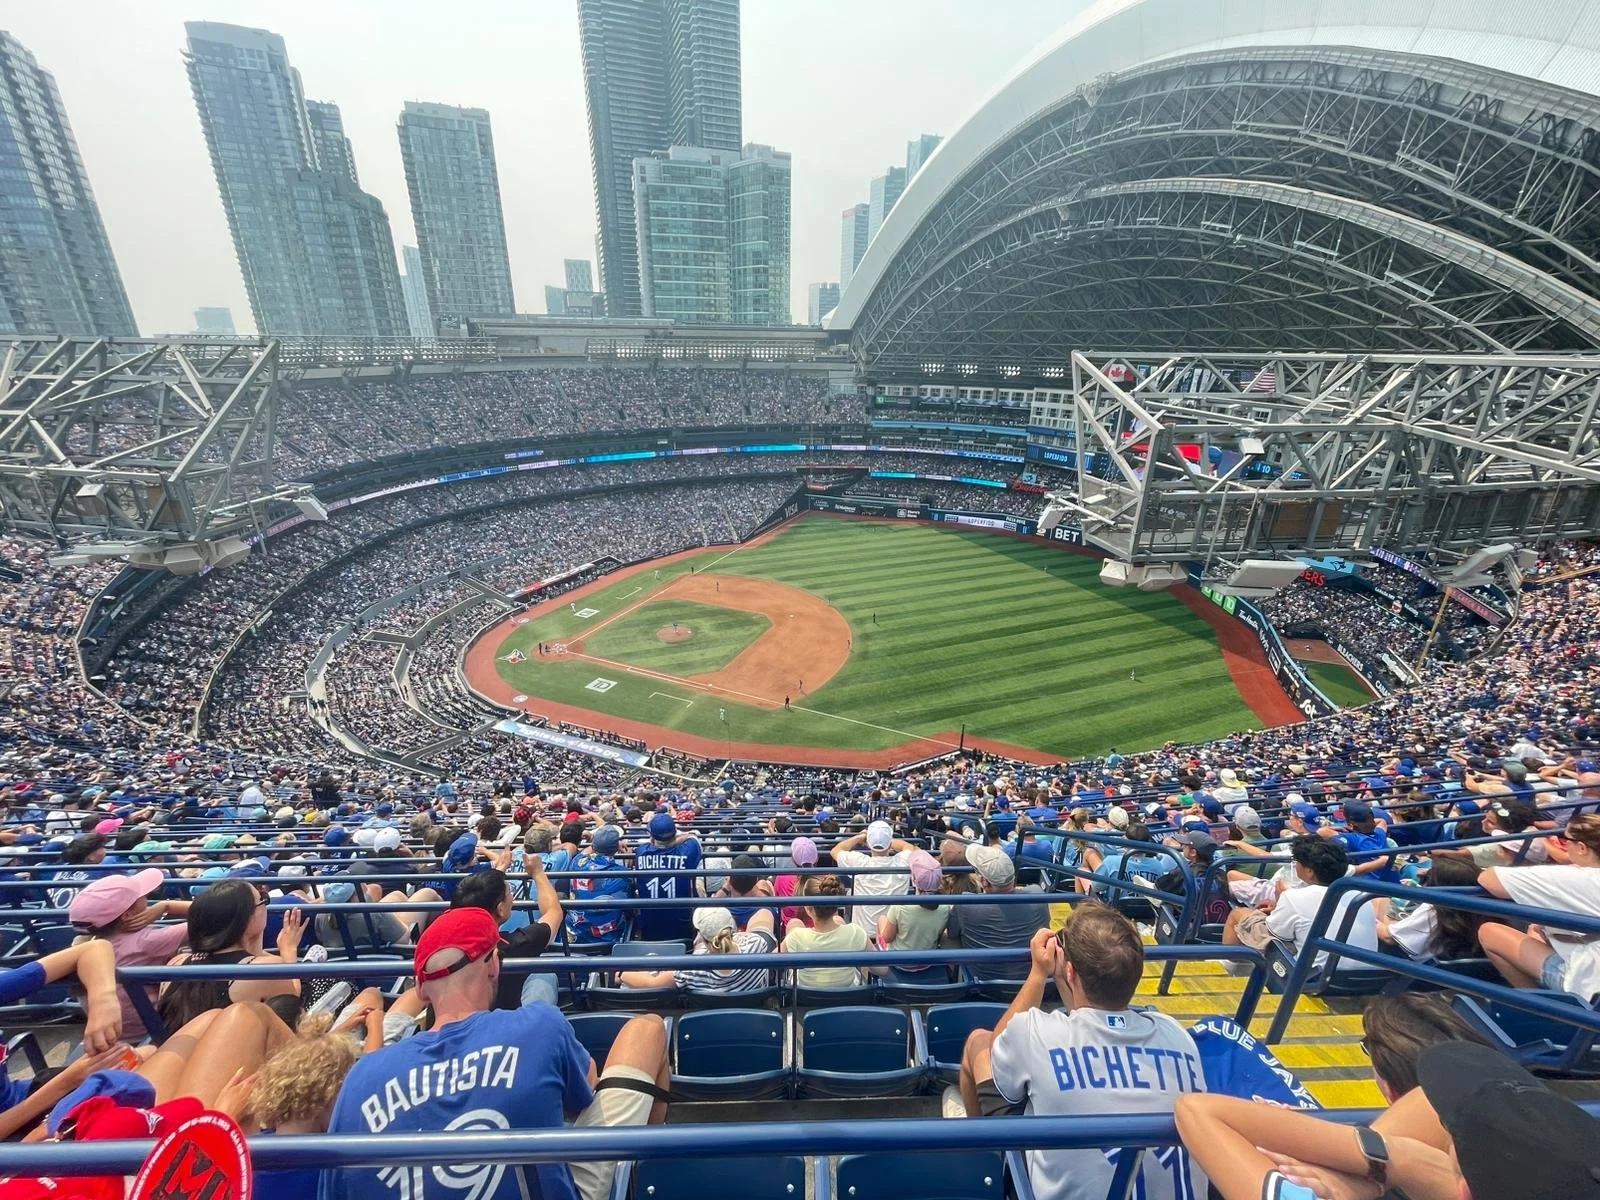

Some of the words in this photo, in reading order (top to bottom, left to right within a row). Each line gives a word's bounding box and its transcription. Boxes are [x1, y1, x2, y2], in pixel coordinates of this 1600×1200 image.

[1055, 527, 1080, 543] BET
[638, 855, 688, 869] BICHETTE
[646, 876, 676, 899] 11
[1049, 1046, 1203, 1093] BICHETTE
[361, 1045, 520, 1133] BAUTISTA
